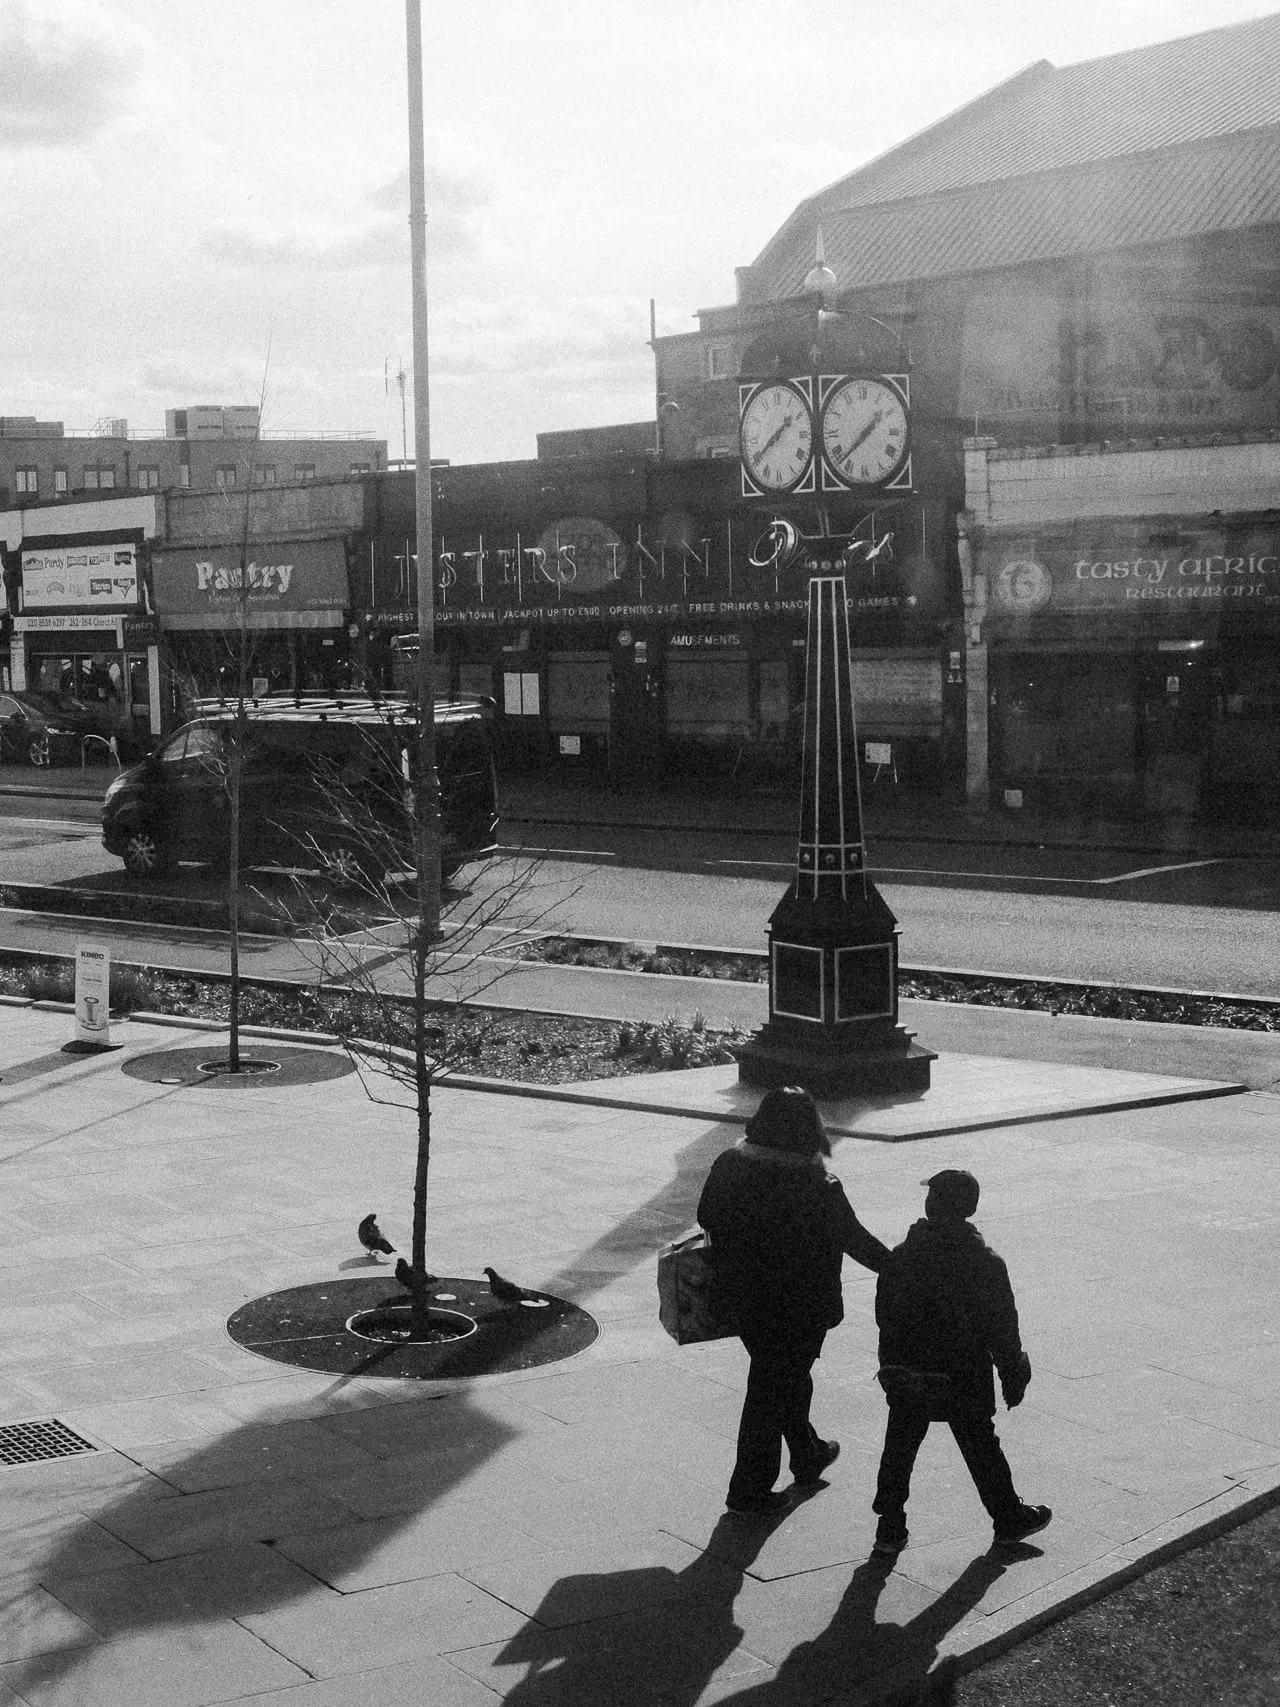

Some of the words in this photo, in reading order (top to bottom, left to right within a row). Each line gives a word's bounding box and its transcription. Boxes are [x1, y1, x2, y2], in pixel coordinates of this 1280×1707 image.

[195, 561, 294, 593] Pantry
[394, 544, 578, 600] JSTERS
[1074, 557, 1170, 584] tasty
[1178, 553, 1280, 583] afric
[377, 612, 414, 622] HIGHEST
[468, 610, 495, 621] TOWN
[503, 608, 544, 619] JACKPOT
[547, 607, 559, 617] UP
[562, 606, 575, 617] TO
[609, 604, 654, 615] OPENING
[689, 602, 716, 613] FREE
[720, 600, 760, 612] DRINKS
[763, 601, 770, 610] &
[774, 599, 809, 611] SNACK
[858, 597, 898, 608] GAMES
[124, 621, 154, 630] Pantry
[670, 634, 741, 646] AMUSEMENTS
[81, 951, 105, 960] KIMBO
